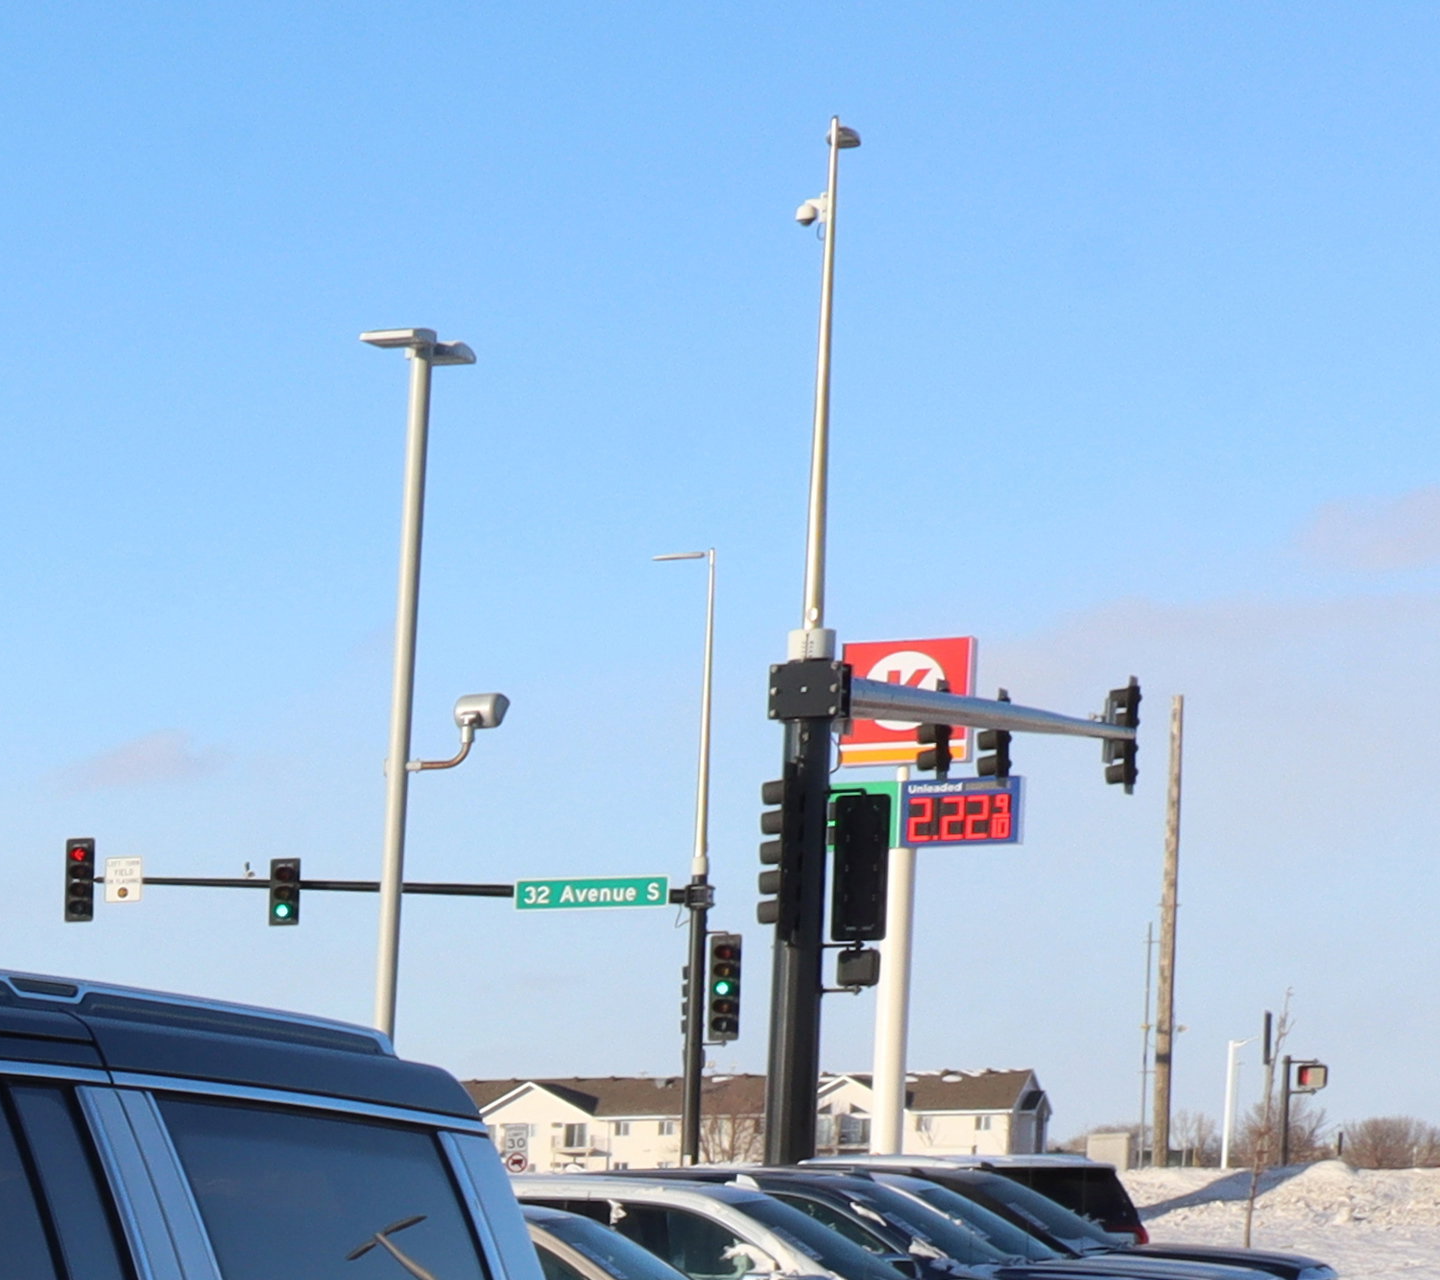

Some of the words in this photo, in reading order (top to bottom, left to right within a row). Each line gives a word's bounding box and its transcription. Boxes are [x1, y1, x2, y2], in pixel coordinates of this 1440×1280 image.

[907, 782, 963, 794] Unleaded
[524, 885, 551, 904] 32
[560, 884, 637, 903] Avenue
[646, 882, 660, 901] S
[507, 1137, 526, 1149] 30
